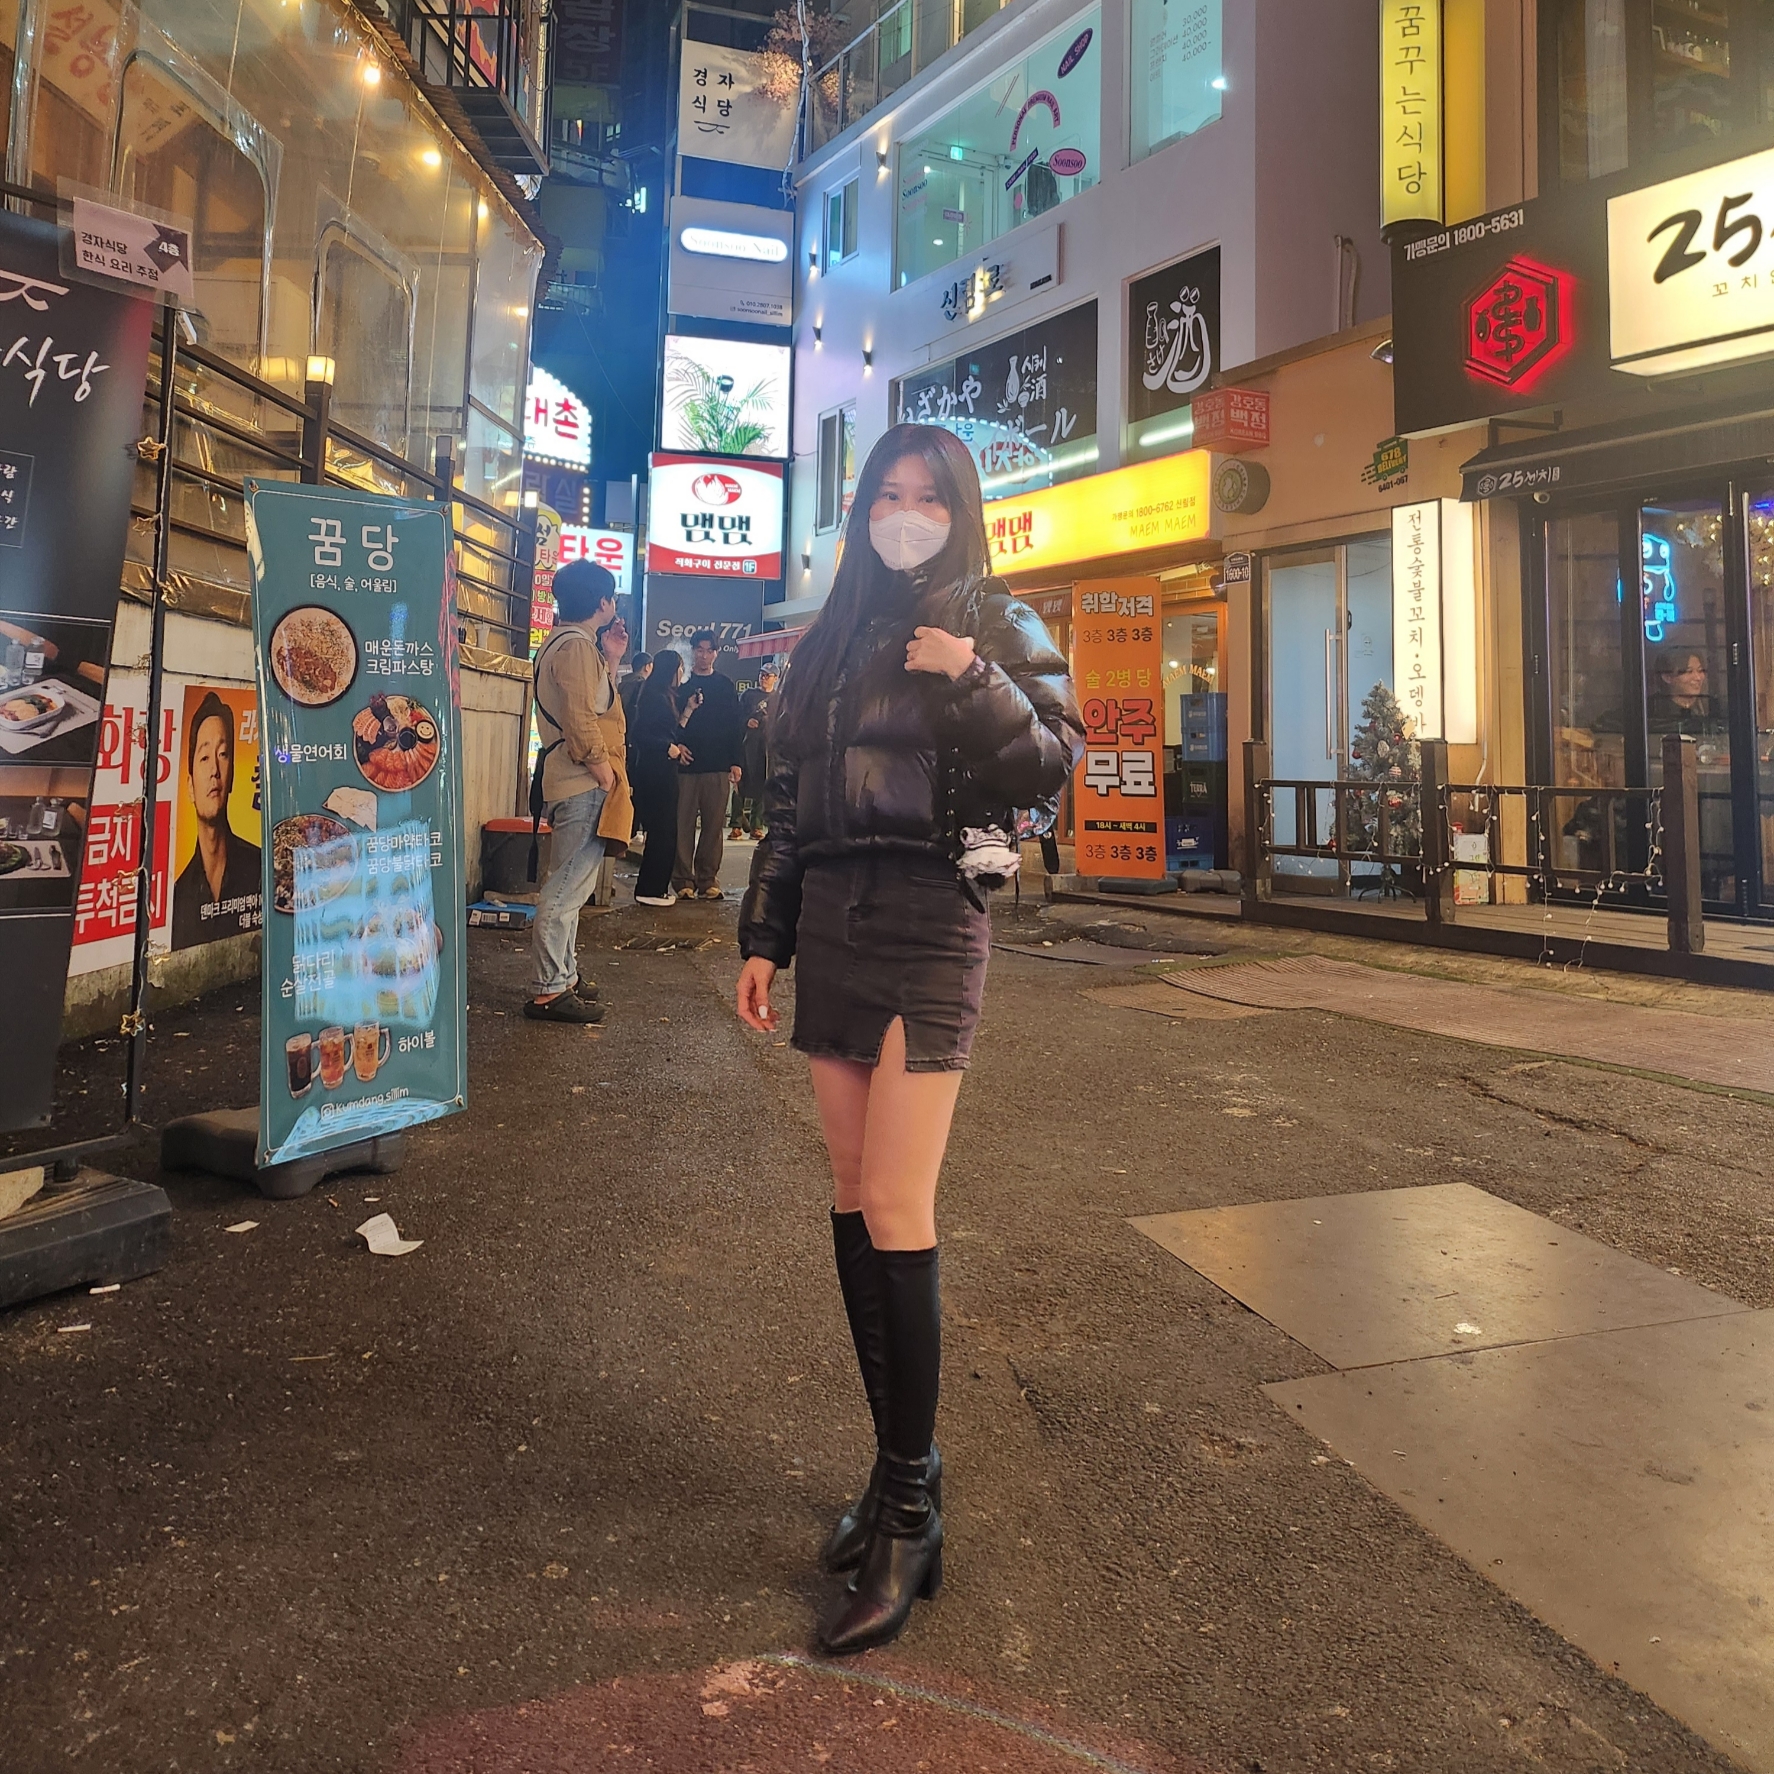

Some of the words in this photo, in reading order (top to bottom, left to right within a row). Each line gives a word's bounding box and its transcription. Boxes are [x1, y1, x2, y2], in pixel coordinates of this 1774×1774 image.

[1060, 55, 1075, 74] NAIL
[693, 67, 735, 91] 경자
[692, 94, 733, 117] 식당
[1394, 5, 1427, 195] 꿈꾸는식당
[1053, 155, 1083, 170] Soonsoo
[902, 178, 928, 199] Soonsoo
[81, 231, 128, 255] 경자식당
[158, 241, 181, 258] 4층
[1403, 232, 1450, 260] 가맹문의
[1453, 208, 1524, 246] 1800-5631
[82, 249, 106, 267] 한식
[110, 258, 133, 275] 요리
[136, 264, 159, 282] 주점
[1229, 394, 1266, 412] 강호동
[1230, 408, 1266, 430] 백정
[1377, 454, 1407, 473] DELIVERY
[1381, 447, 1402, 461] 678
[1136, 500, 1174, 517] 1800-6762
[1130, 520, 1160, 538] MAEM
[1164, 513, 1196, 533] MAEM
[744, 560, 756, 573] 1F
[343, 575, 358, 593] 술,
[360, 577, 397, 593] 어울림]
[720, 622, 752, 639] 771
[1082, 629, 1103, 644] 3층
[1106, 627, 1128, 643] 3층
[1131, 626, 1153, 642] 3층
[364, 640, 434, 657] 매운돈까스
[1085, 669, 1101, 689] 술
[1105, 668, 1131, 688] 2병
[1136, 668, 1152, 688] 당
[1163, 665, 1188, 688] MAEM
[1189, 664, 1214, 685] MAEM
[1083, 698, 1156, 745] 안주
[274, 743, 347, 764] 생물연어회
[1084, 751, 1156, 797] 무료
[1190, 782, 1207, 794] TERRA
[1095, 821, 1111, 830] 18시
[1119, 822, 1133, 831] 새벽
[1134, 822, 1145, 831] 4시
[87, 815, 133, 866] 금지
[366, 832, 443, 853] 꿈당마약타코
[367, 852, 443, 875] 꿈당불닭타코
[1085, 844, 1106, 860] 3층
[1110, 845, 1132, 860] 3층
[1135, 846, 1157, 862] 3층
[221, 895, 246, 915] 프리미엄
[238, 912, 251, 929] 더블
[292, 950, 335, 974] 닭다리
[281, 974, 336, 998] 순살전골
[398, 1029, 436, 1053] 하이볼
